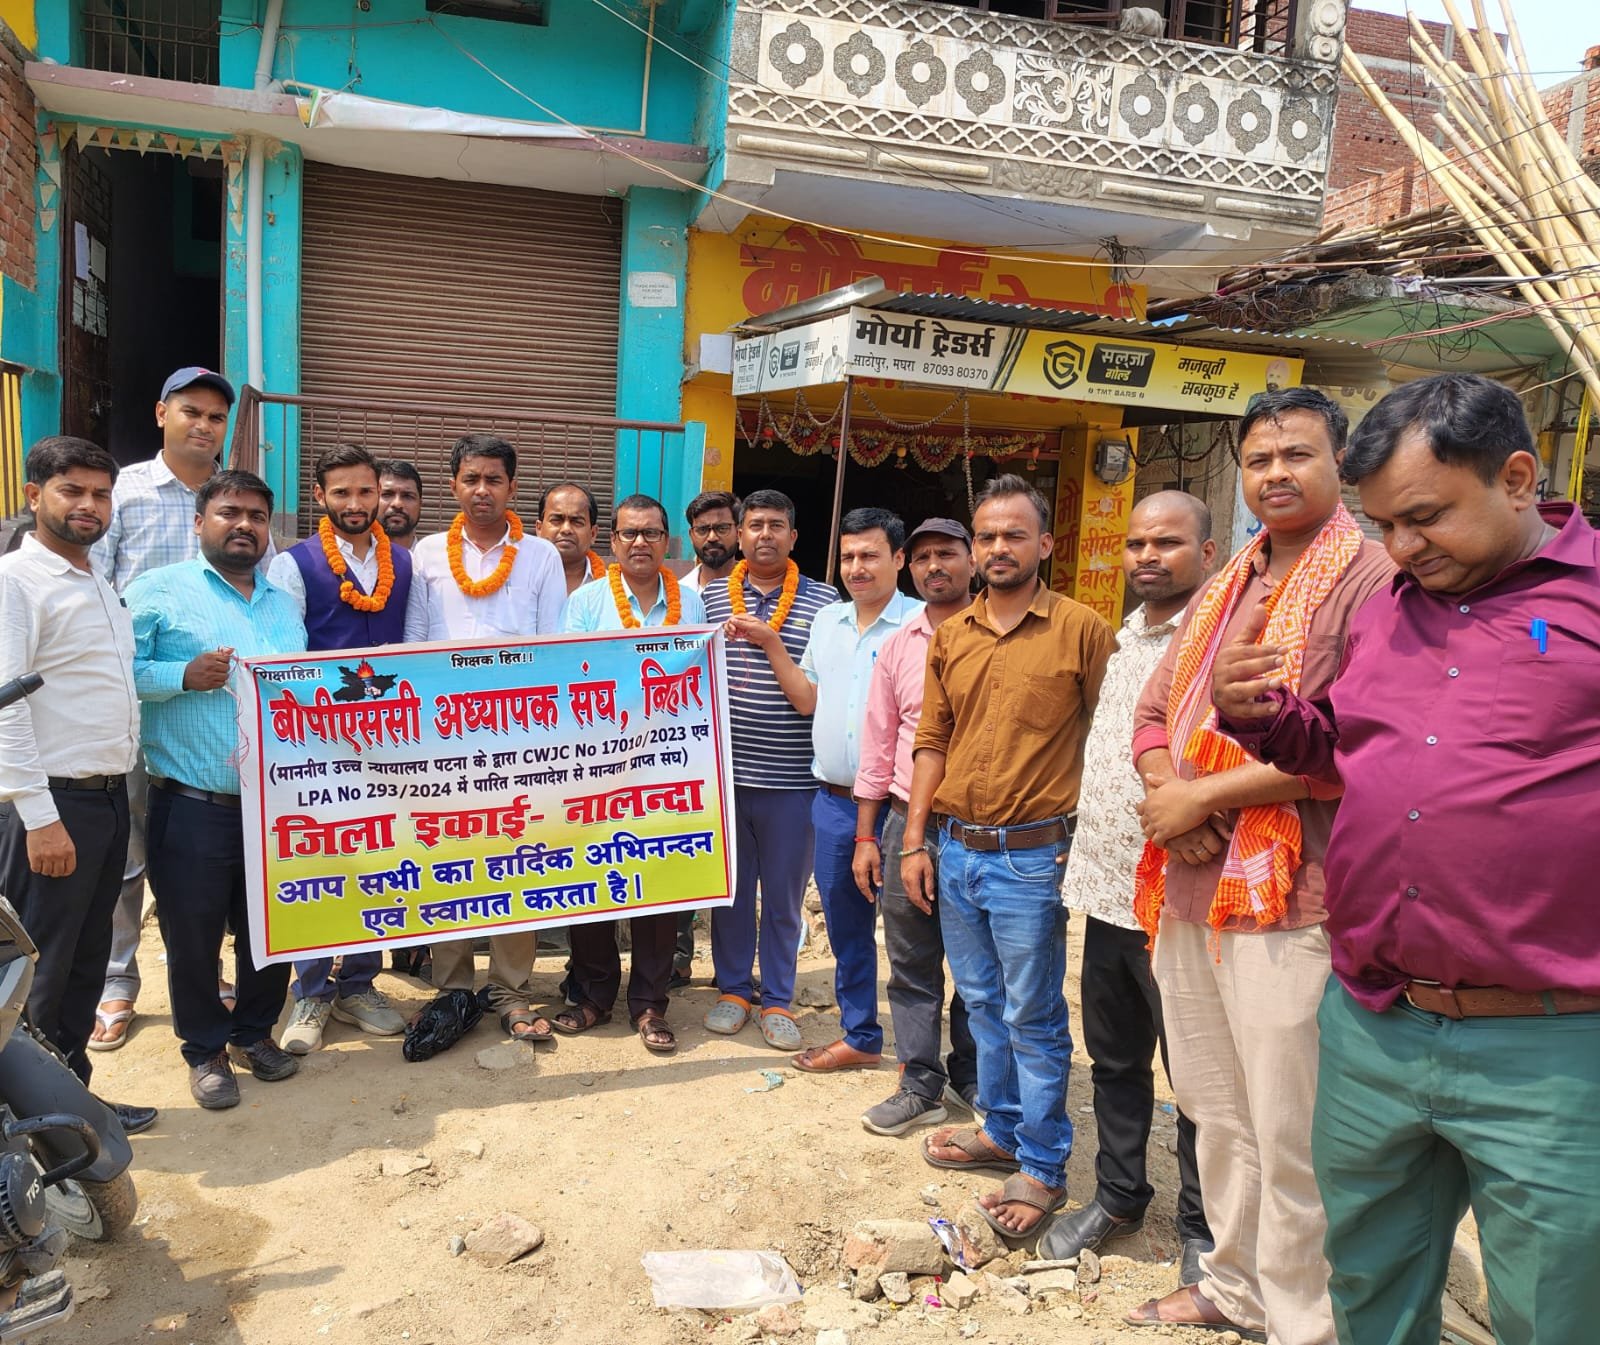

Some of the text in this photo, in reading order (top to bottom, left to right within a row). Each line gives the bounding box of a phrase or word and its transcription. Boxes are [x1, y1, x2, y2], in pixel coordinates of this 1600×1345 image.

[856, 314, 926, 349] मोर्या
[930, 320, 996, 358] ट्रेडर्स
[893, 358, 915, 372] मघरा
[923, 363, 953, 376] 87093
[957, 366, 988, 380] 80370
[1105, 366, 1132, 381] गोल्ड
[1096, 388, 1137, 398] TMT BARS
[1181, 381, 1240, 403] सबकुछ है
[1079, 565, 1121, 595] बालू
[451, 650, 533, 668] शिक्षक हित!!
[635, 642, 669, 653] समाज
[434, 685, 559, 738] अध्यापक
[568, 661, 629, 733] संघ,
[641, 658, 703, 719] बिहार
[269, 718, 709, 786] (माननीय उच्च न्यायालय पटना के द्वारा CWJC No 17010/2023 एवं
[298, 745, 688, 807] LPA No 293/2024 में पारित न्यायादेश से मान्यता प्राप्त संघ)
[271, 779, 705, 860] जिला इकाई- नालन्दा
[277, 831, 714, 903] आप सभी का हार्दिक अभिनन्दन
[362, 898, 407, 936] एवं
[420, 892, 512, 925] स्वागत
[523, 882, 597, 911] करता
[26, 1178, 40, 1204] TVS
